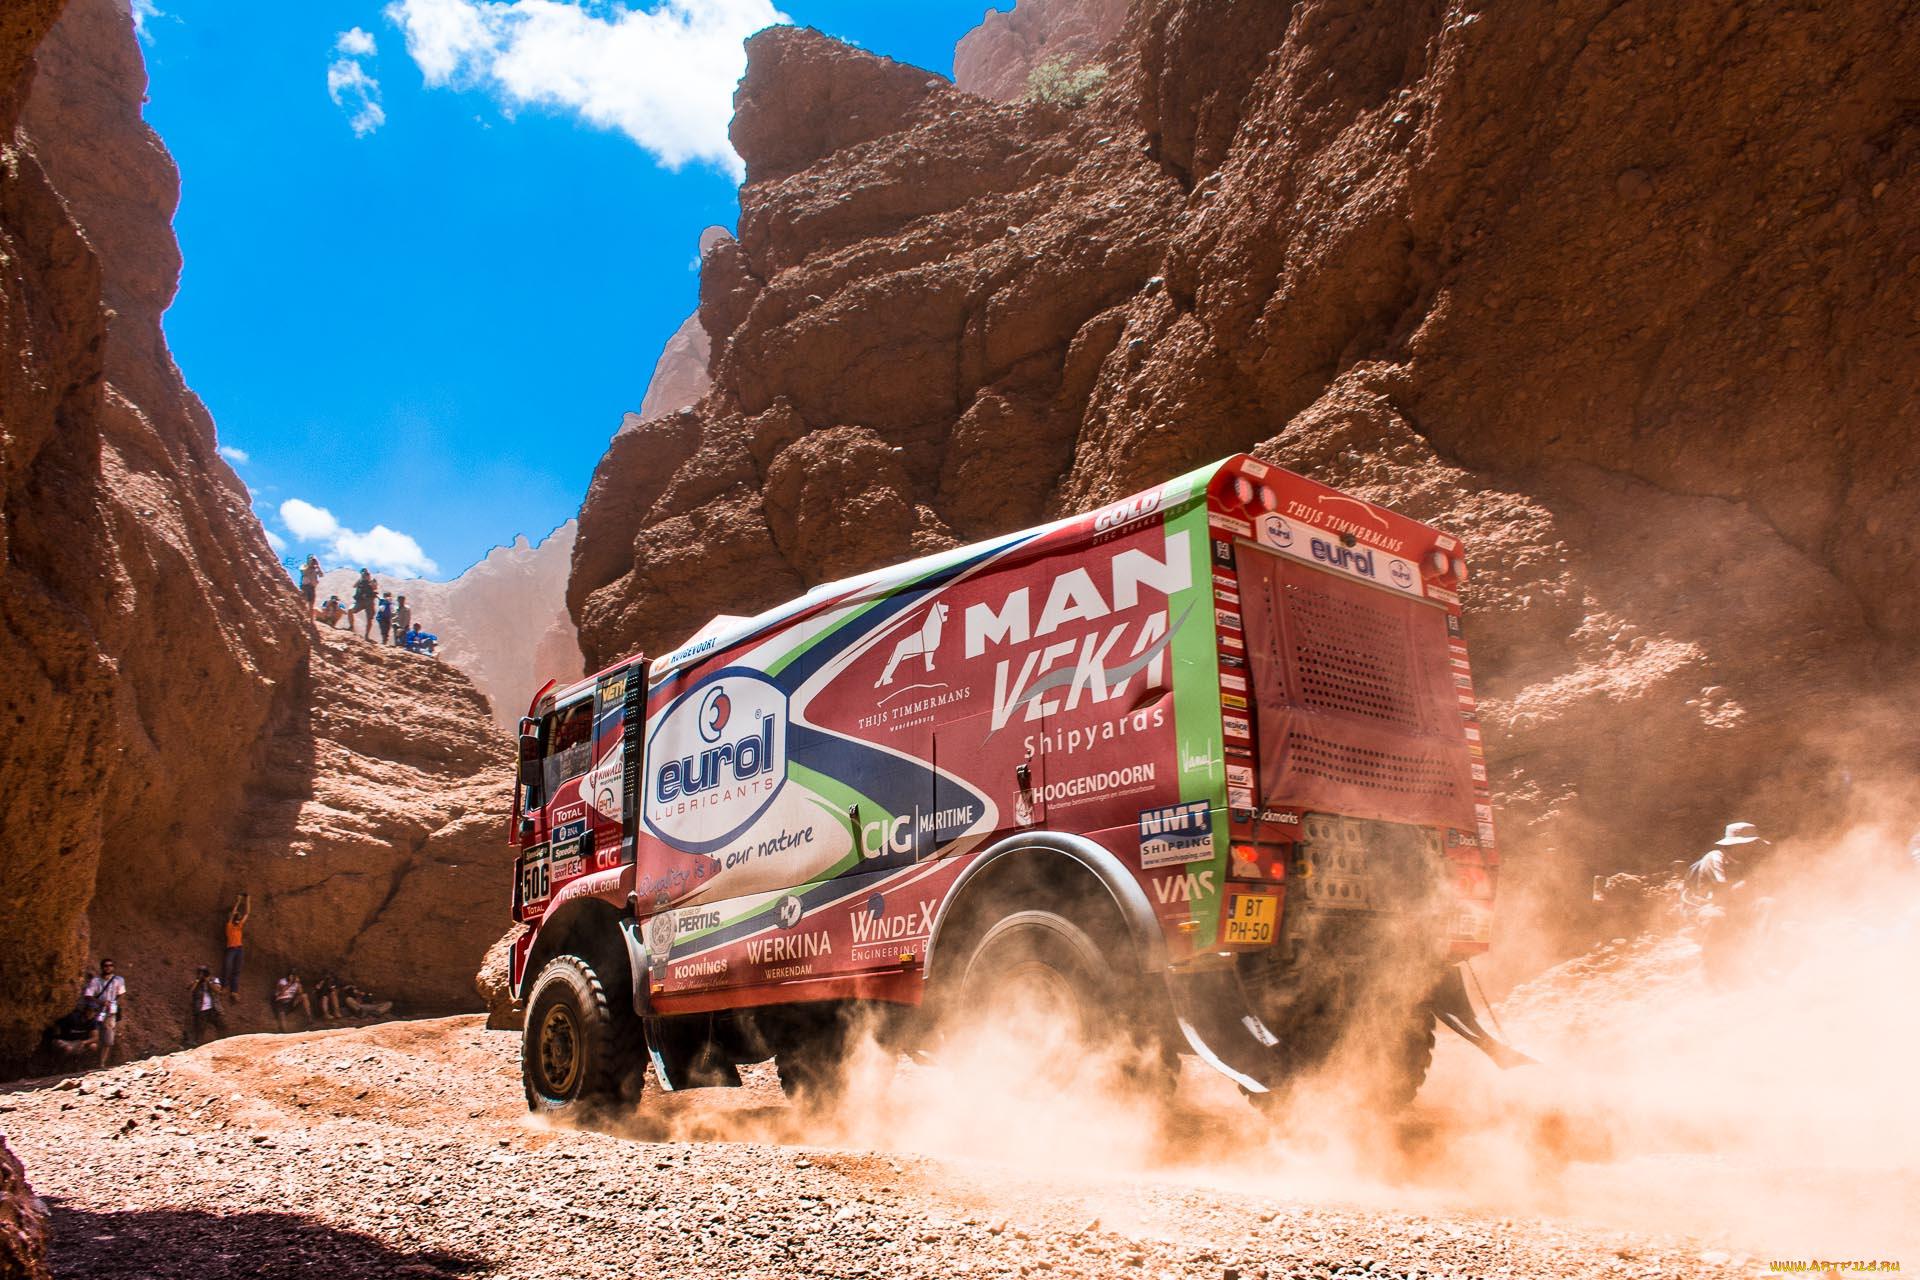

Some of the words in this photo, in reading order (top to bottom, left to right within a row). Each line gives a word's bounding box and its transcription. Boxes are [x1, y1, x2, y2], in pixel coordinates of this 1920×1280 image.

[1094, 491, 1161, 531] GOLD
[1287, 500, 1323, 523] THIJS
[1325, 515, 1404, 552] TIMMERMANS
[1093, 532, 1117, 545] DISC
[1122, 517, 1157, 534] BRAKE
[1310, 537, 1376, 578] eurol
[965, 529, 1192, 659] MAN
[991, 610, 1168, 731] VEKA
[858, 712, 888, 729] THIJS
[892, 686, 970, 718] TIMMERMANS
[1023, 708, 1164, 759] Shipyards
[657, 713, 775, 804] eurol
[655, 777, 773, 821] LUBRICANTS
[1032, 762, 1155, 804] HOOGENDOORN
[557, 808, 582, 822] TOTAL
[919, 805, 973, 833] MARITIME
[1141, 802, 1209, 836] NMT
[1251, 807, 1299, 825] Dckmarks
[861, 815, 912, 859] CIG
[1143, 837, 1211, 855] SHIPPING
[596, 849, 618, 869] CIG
[639, 866, 690, 897] Quality
[694, 859, 704, 878] is
[710, 854, 722, 873] in
[726, 847, 753, 870] our
[758, 826, 814, 857] nature
[524, 864, 549, 901] 506
[558, 877, 620, 902] TrucksXL.com
[1152, 870, 1215, 904] VMS
[526, 905, 545, 915] TOTAL
[679, 908, 694, 917] HOUSE
[1245, 898, 1263, 917] BT
[747, 930, 832, 965] WERKINA
[1229, 921, 1270, 940] PH-50
[851, 944, 918, 961] ENGINEERING
[765, 965, 812, 979] WERKENDAM
